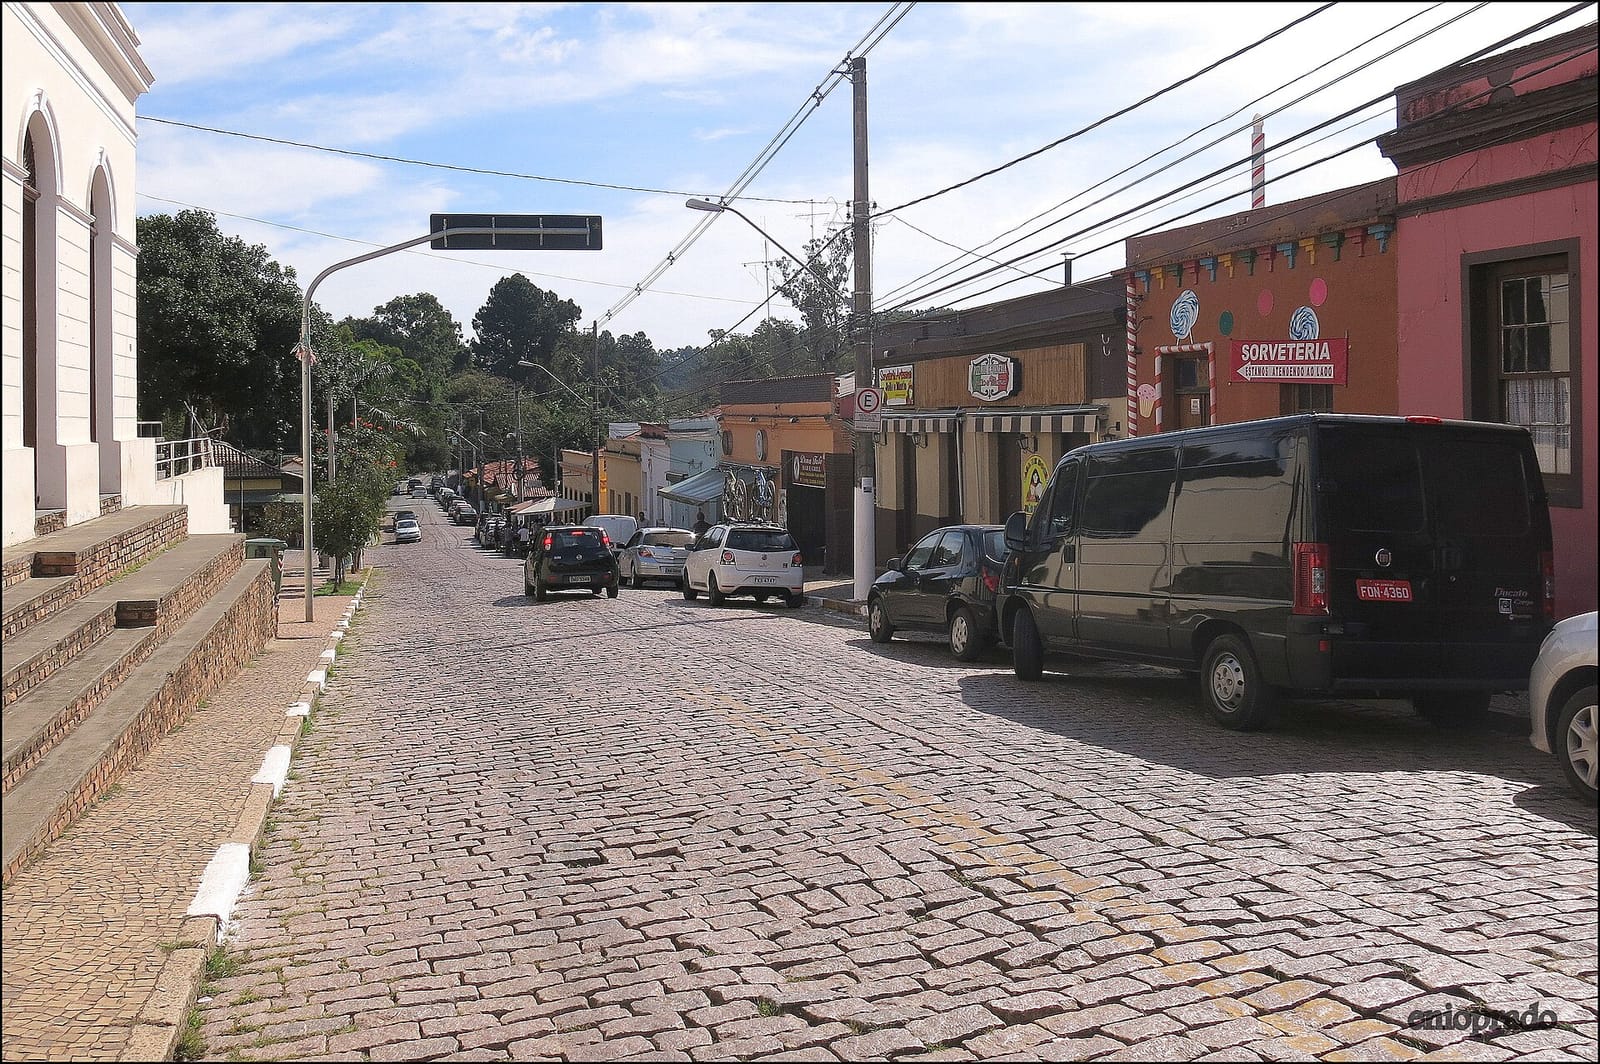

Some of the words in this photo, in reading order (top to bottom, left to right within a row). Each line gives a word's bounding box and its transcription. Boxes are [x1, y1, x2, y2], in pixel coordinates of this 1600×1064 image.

[1241, 342, 1331, 361] SORVETERIA
[1245, 366, 1269, 377] ESTAMOS
[1271, 366, 1304, 377] ATENDENDO
[1306, 366, 1315, 377] AO
[1316, 366, 1333, 377] LADO
[864, 394, 872, 407] E
[1494, 587, 1529, 598] Ducato
